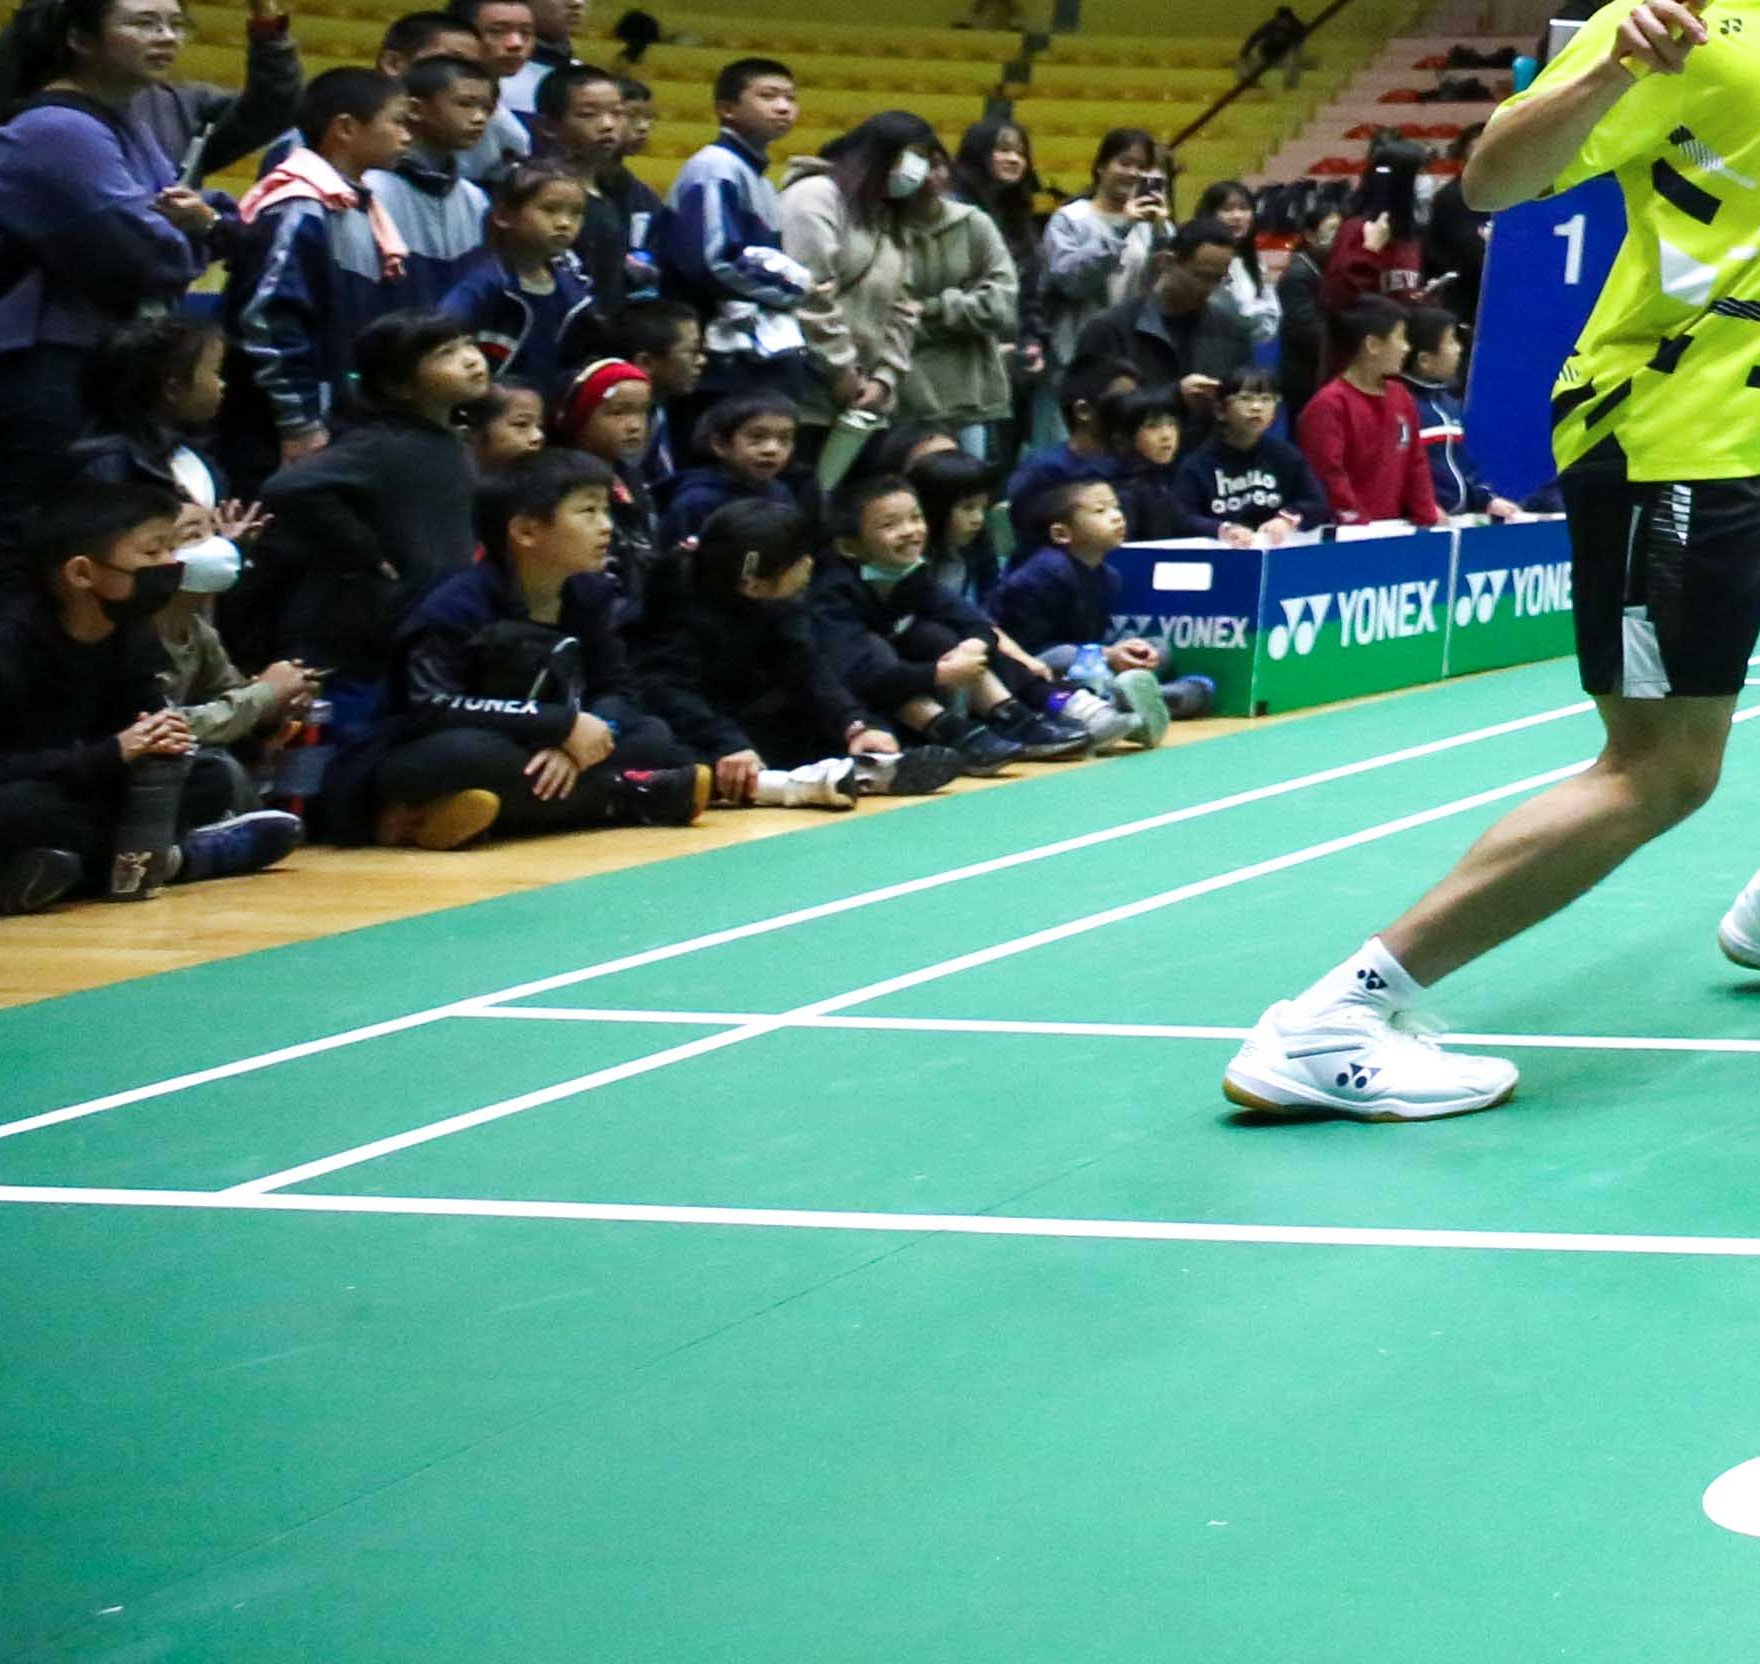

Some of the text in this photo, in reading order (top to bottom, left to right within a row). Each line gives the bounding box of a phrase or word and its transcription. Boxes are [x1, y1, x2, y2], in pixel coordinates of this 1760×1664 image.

[1553, 214, 1586, 285] 1
[1337, 579, 1439, 647] YONEX
[1511, 561, 1573, 617] YONE
[1158, 615, 1249, 649] YONEX
